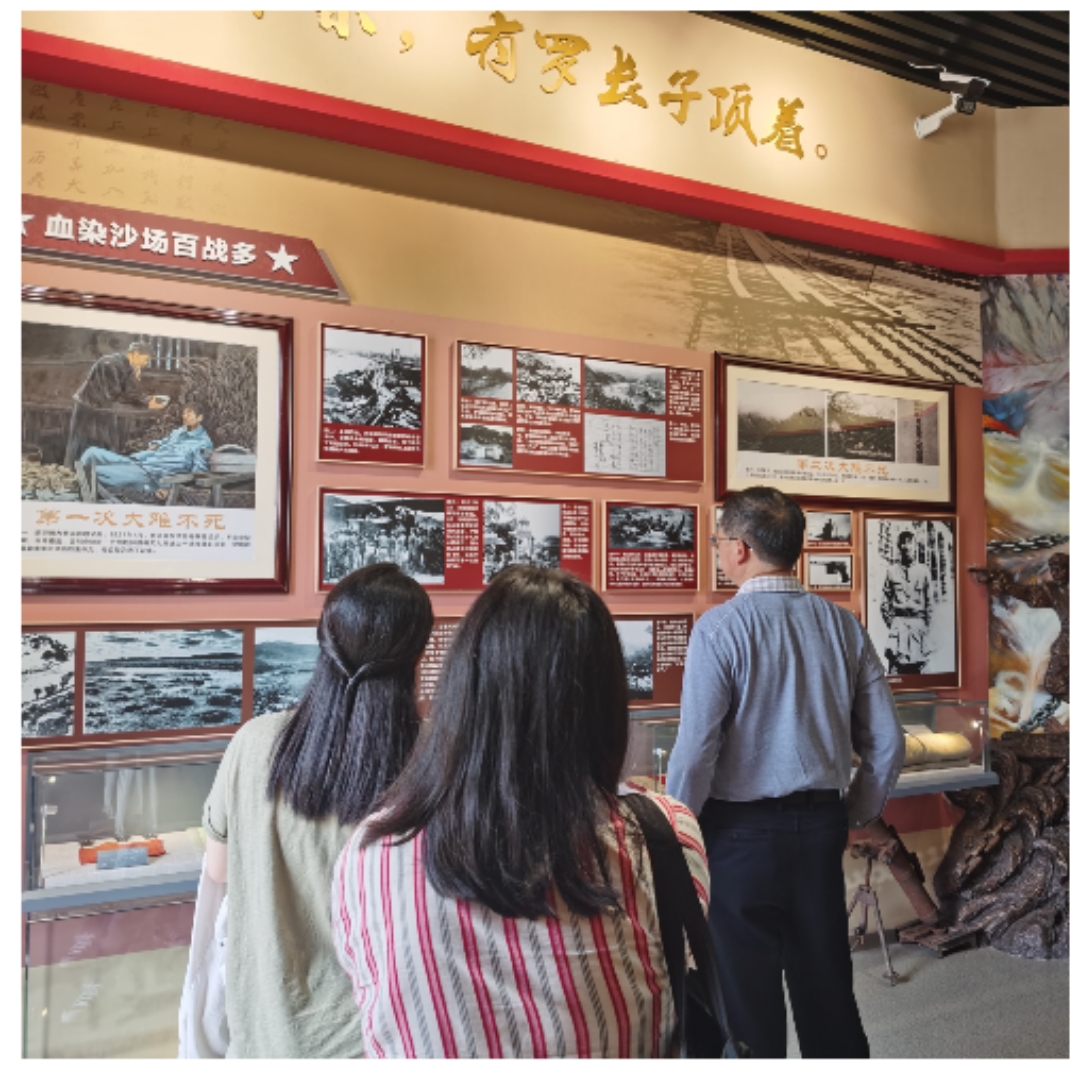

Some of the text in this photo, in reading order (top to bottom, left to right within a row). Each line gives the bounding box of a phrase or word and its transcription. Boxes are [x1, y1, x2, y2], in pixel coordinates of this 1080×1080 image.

[46, 212, 257, 266] 血染沙场百战多
[36, 508, 226, 530] 第一次大难不死
